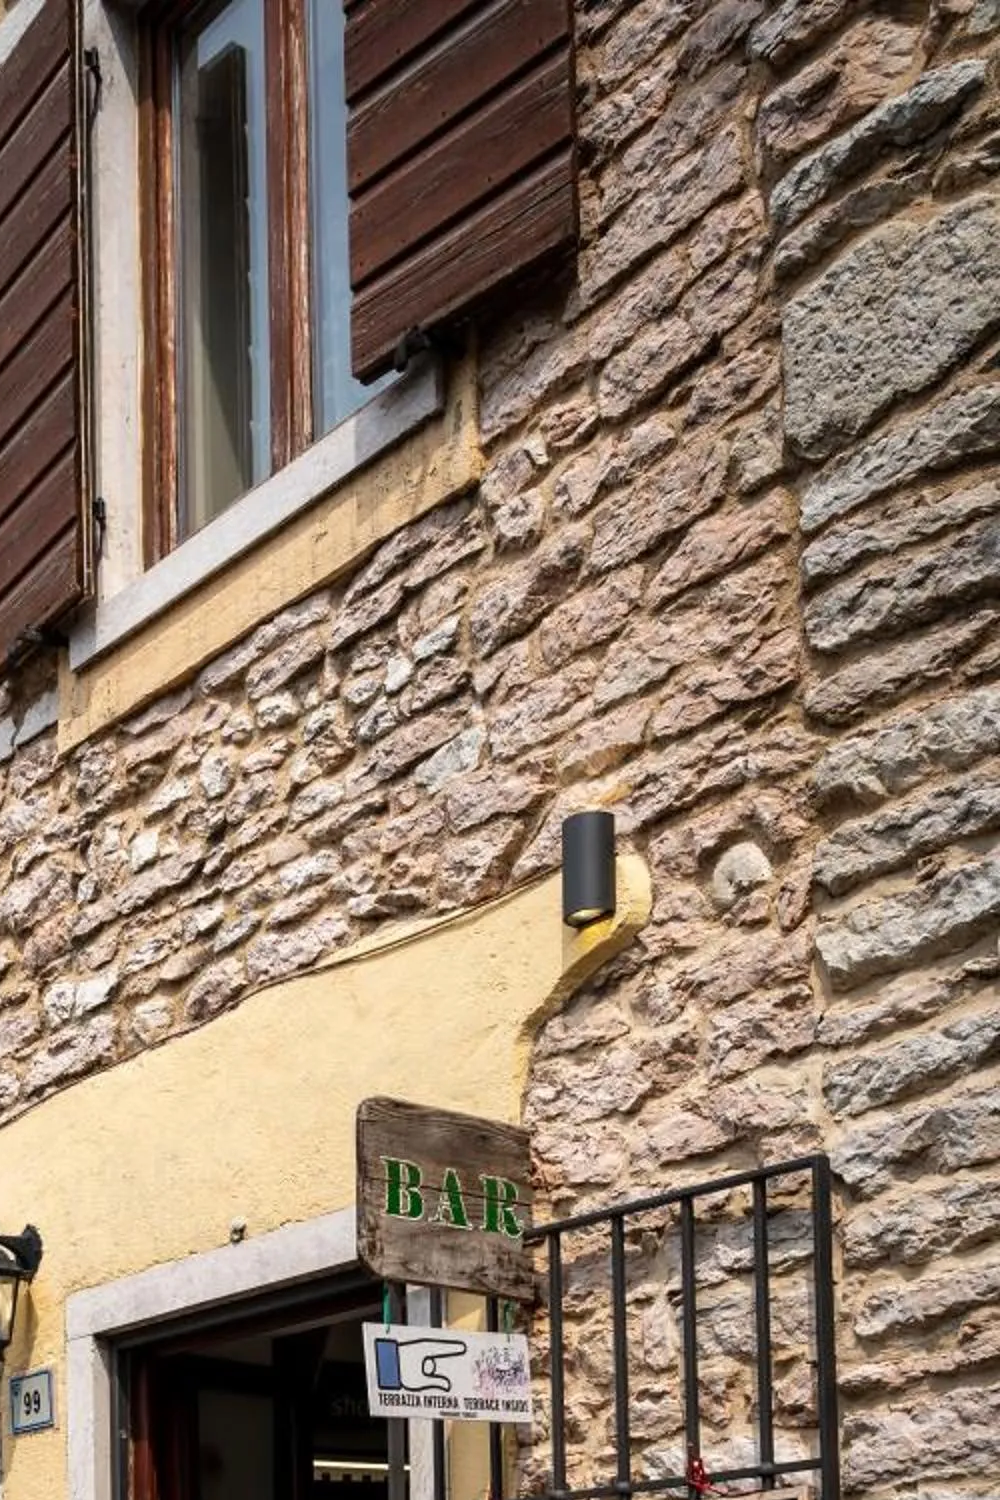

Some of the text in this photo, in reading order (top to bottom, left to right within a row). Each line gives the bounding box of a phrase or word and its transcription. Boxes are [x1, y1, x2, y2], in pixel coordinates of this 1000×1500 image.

[379, 1155, 525, 1240] BAR
[24, 1390, 41, 1415] 99
[378, 1393, 422, 1408] TERRAZZA
[423, 1395, 459, 1409] INTERNA
[463, 1397, 499, 1411] TERRACE
